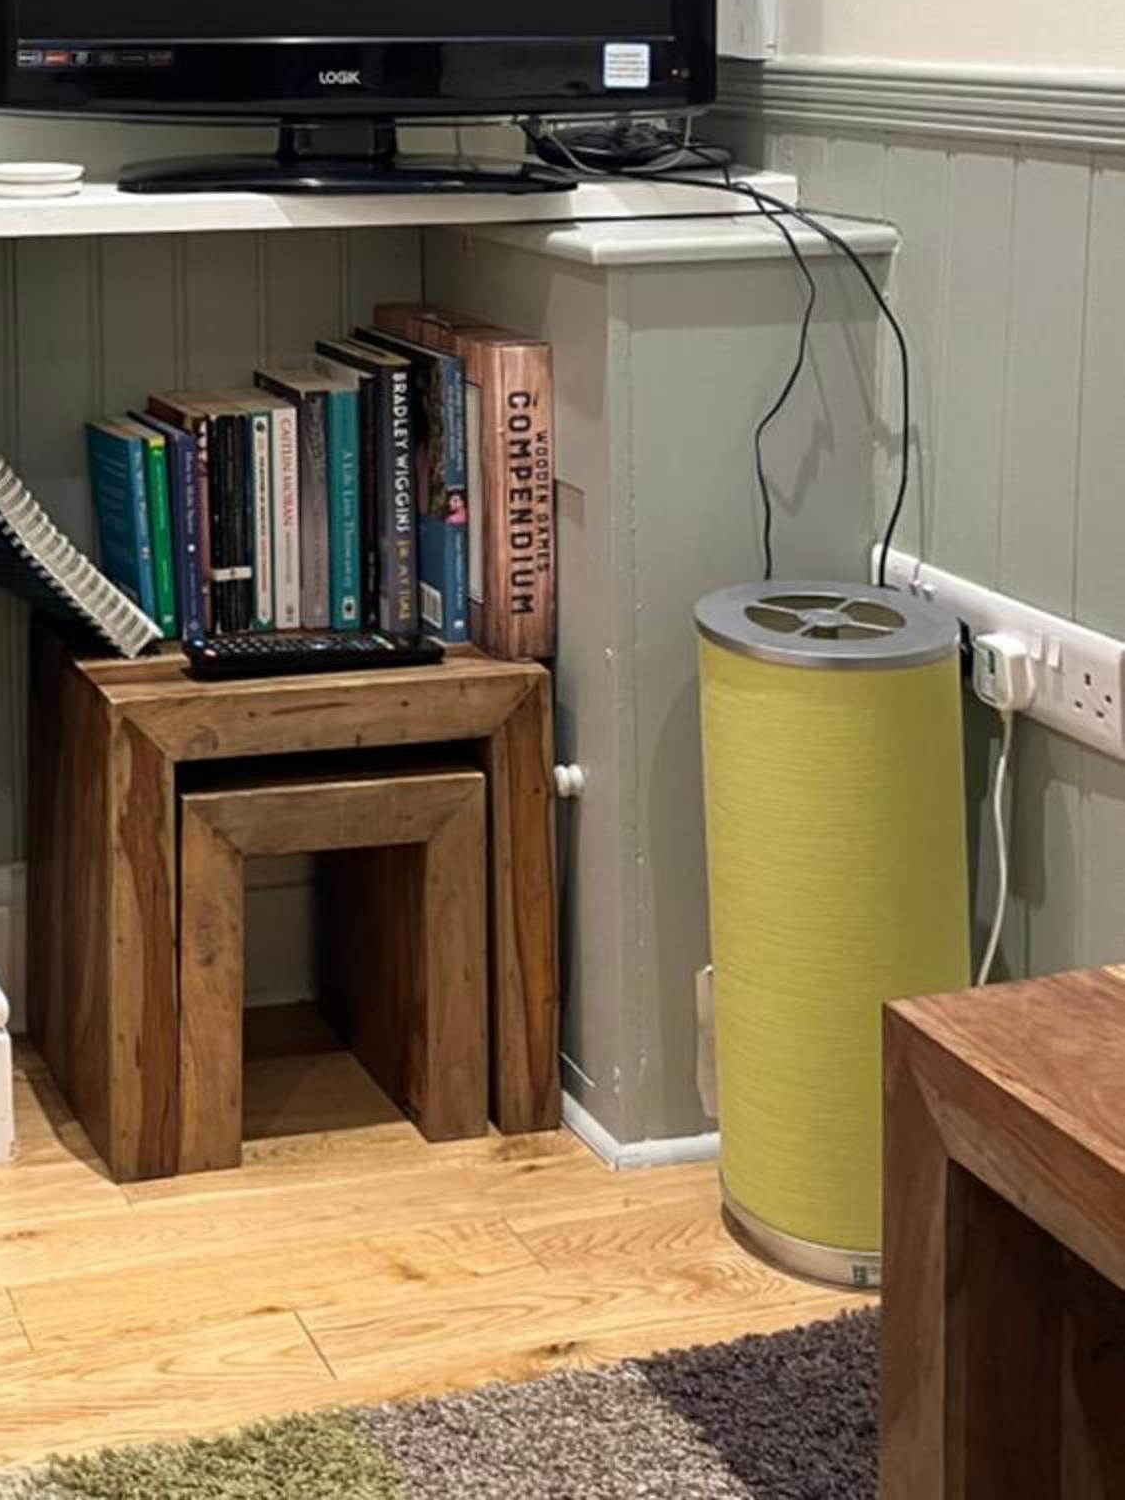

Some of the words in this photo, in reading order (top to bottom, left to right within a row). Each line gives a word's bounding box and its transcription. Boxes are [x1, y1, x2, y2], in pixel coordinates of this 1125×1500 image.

[318, 70, 361, 85] LOGIK
[393, 372, 409, 449] BRADLEY
[280, 417, 293, 472] CAITLIN
[535, 429, 549, 503] WOODEN
[282, 474, 294, 527] MORAN
[394, 452, 411, 533] WIGGINS
[507, 390, 534, 615] COMPENDIUM
[536, 513, 551, 573] GAMES
